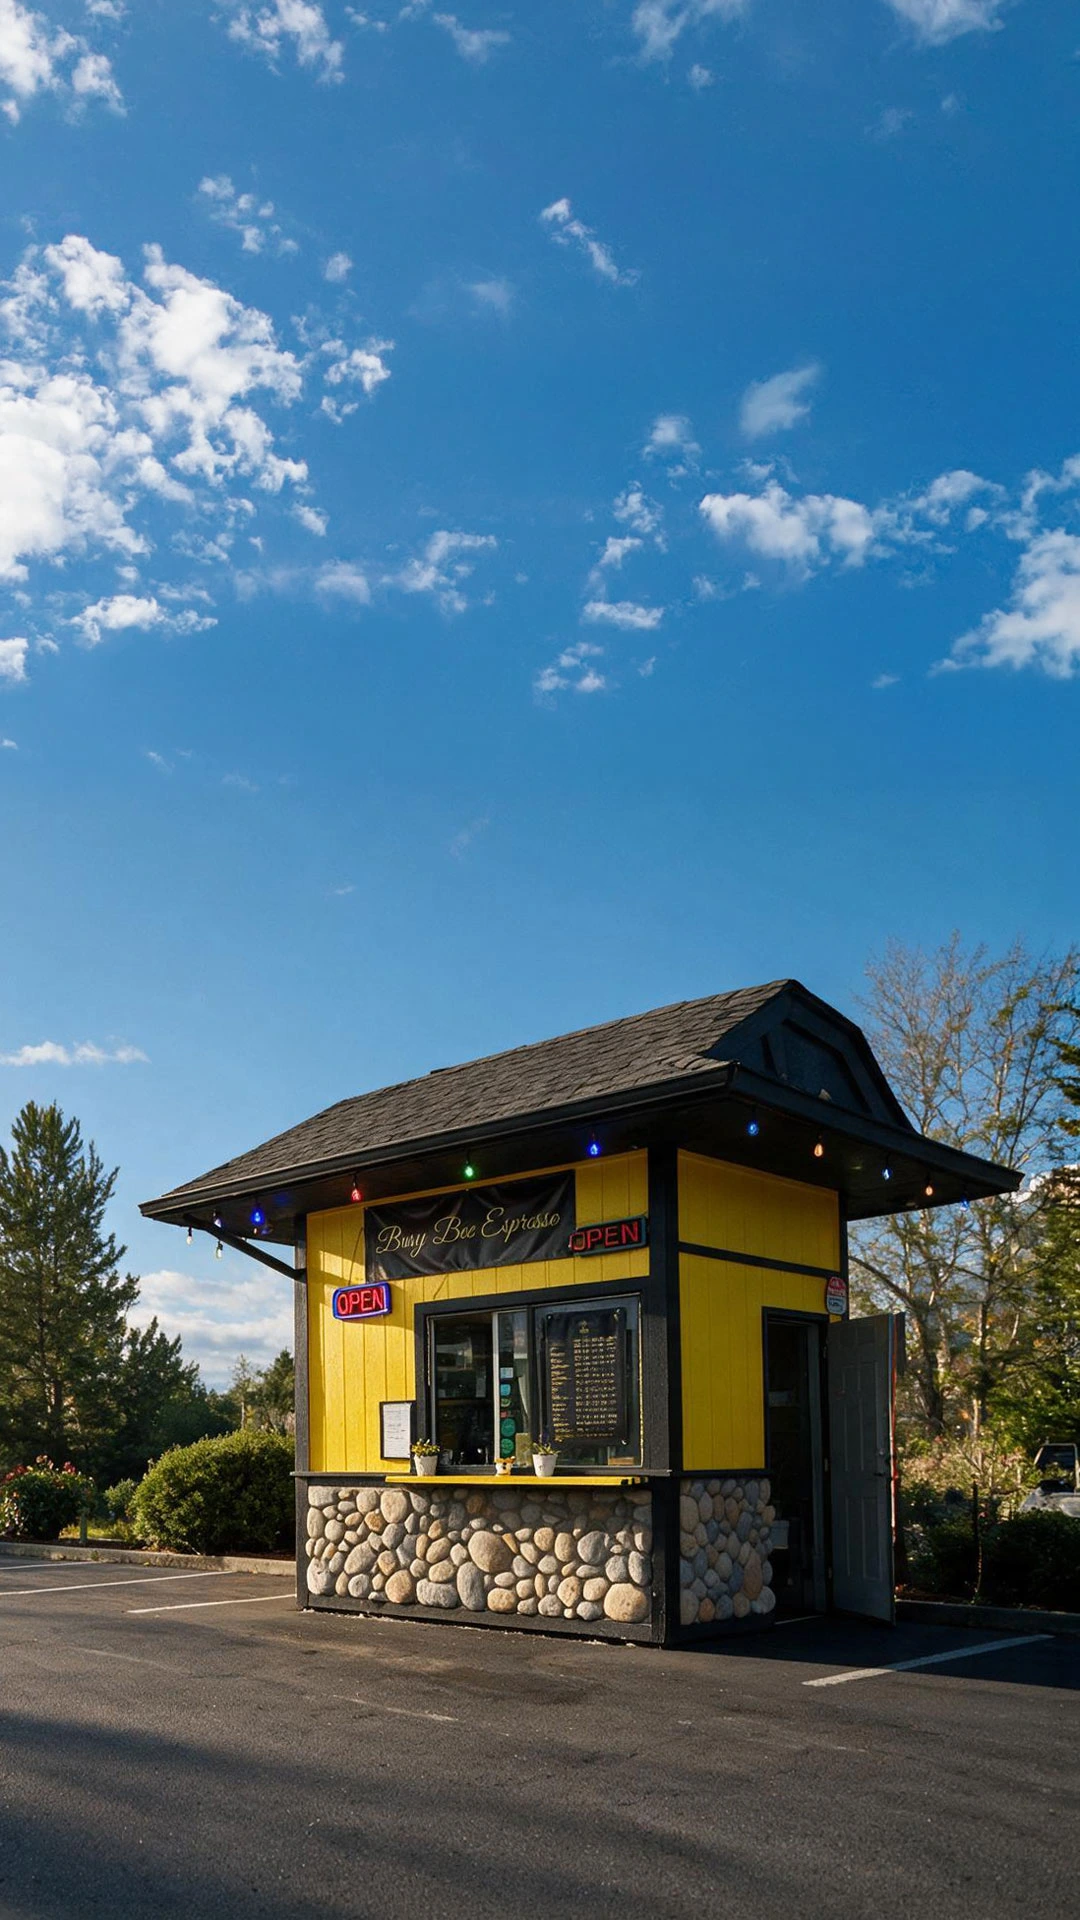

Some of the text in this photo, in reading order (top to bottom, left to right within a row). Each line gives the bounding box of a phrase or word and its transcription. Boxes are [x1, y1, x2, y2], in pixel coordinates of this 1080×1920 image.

[376, 1225, 426, 1258] Busy
[433, 1216, 475, 1244] Bee
[568, 1221, 639, 1251] OPEN
[337, 1287, 383, 1314] OPEN
